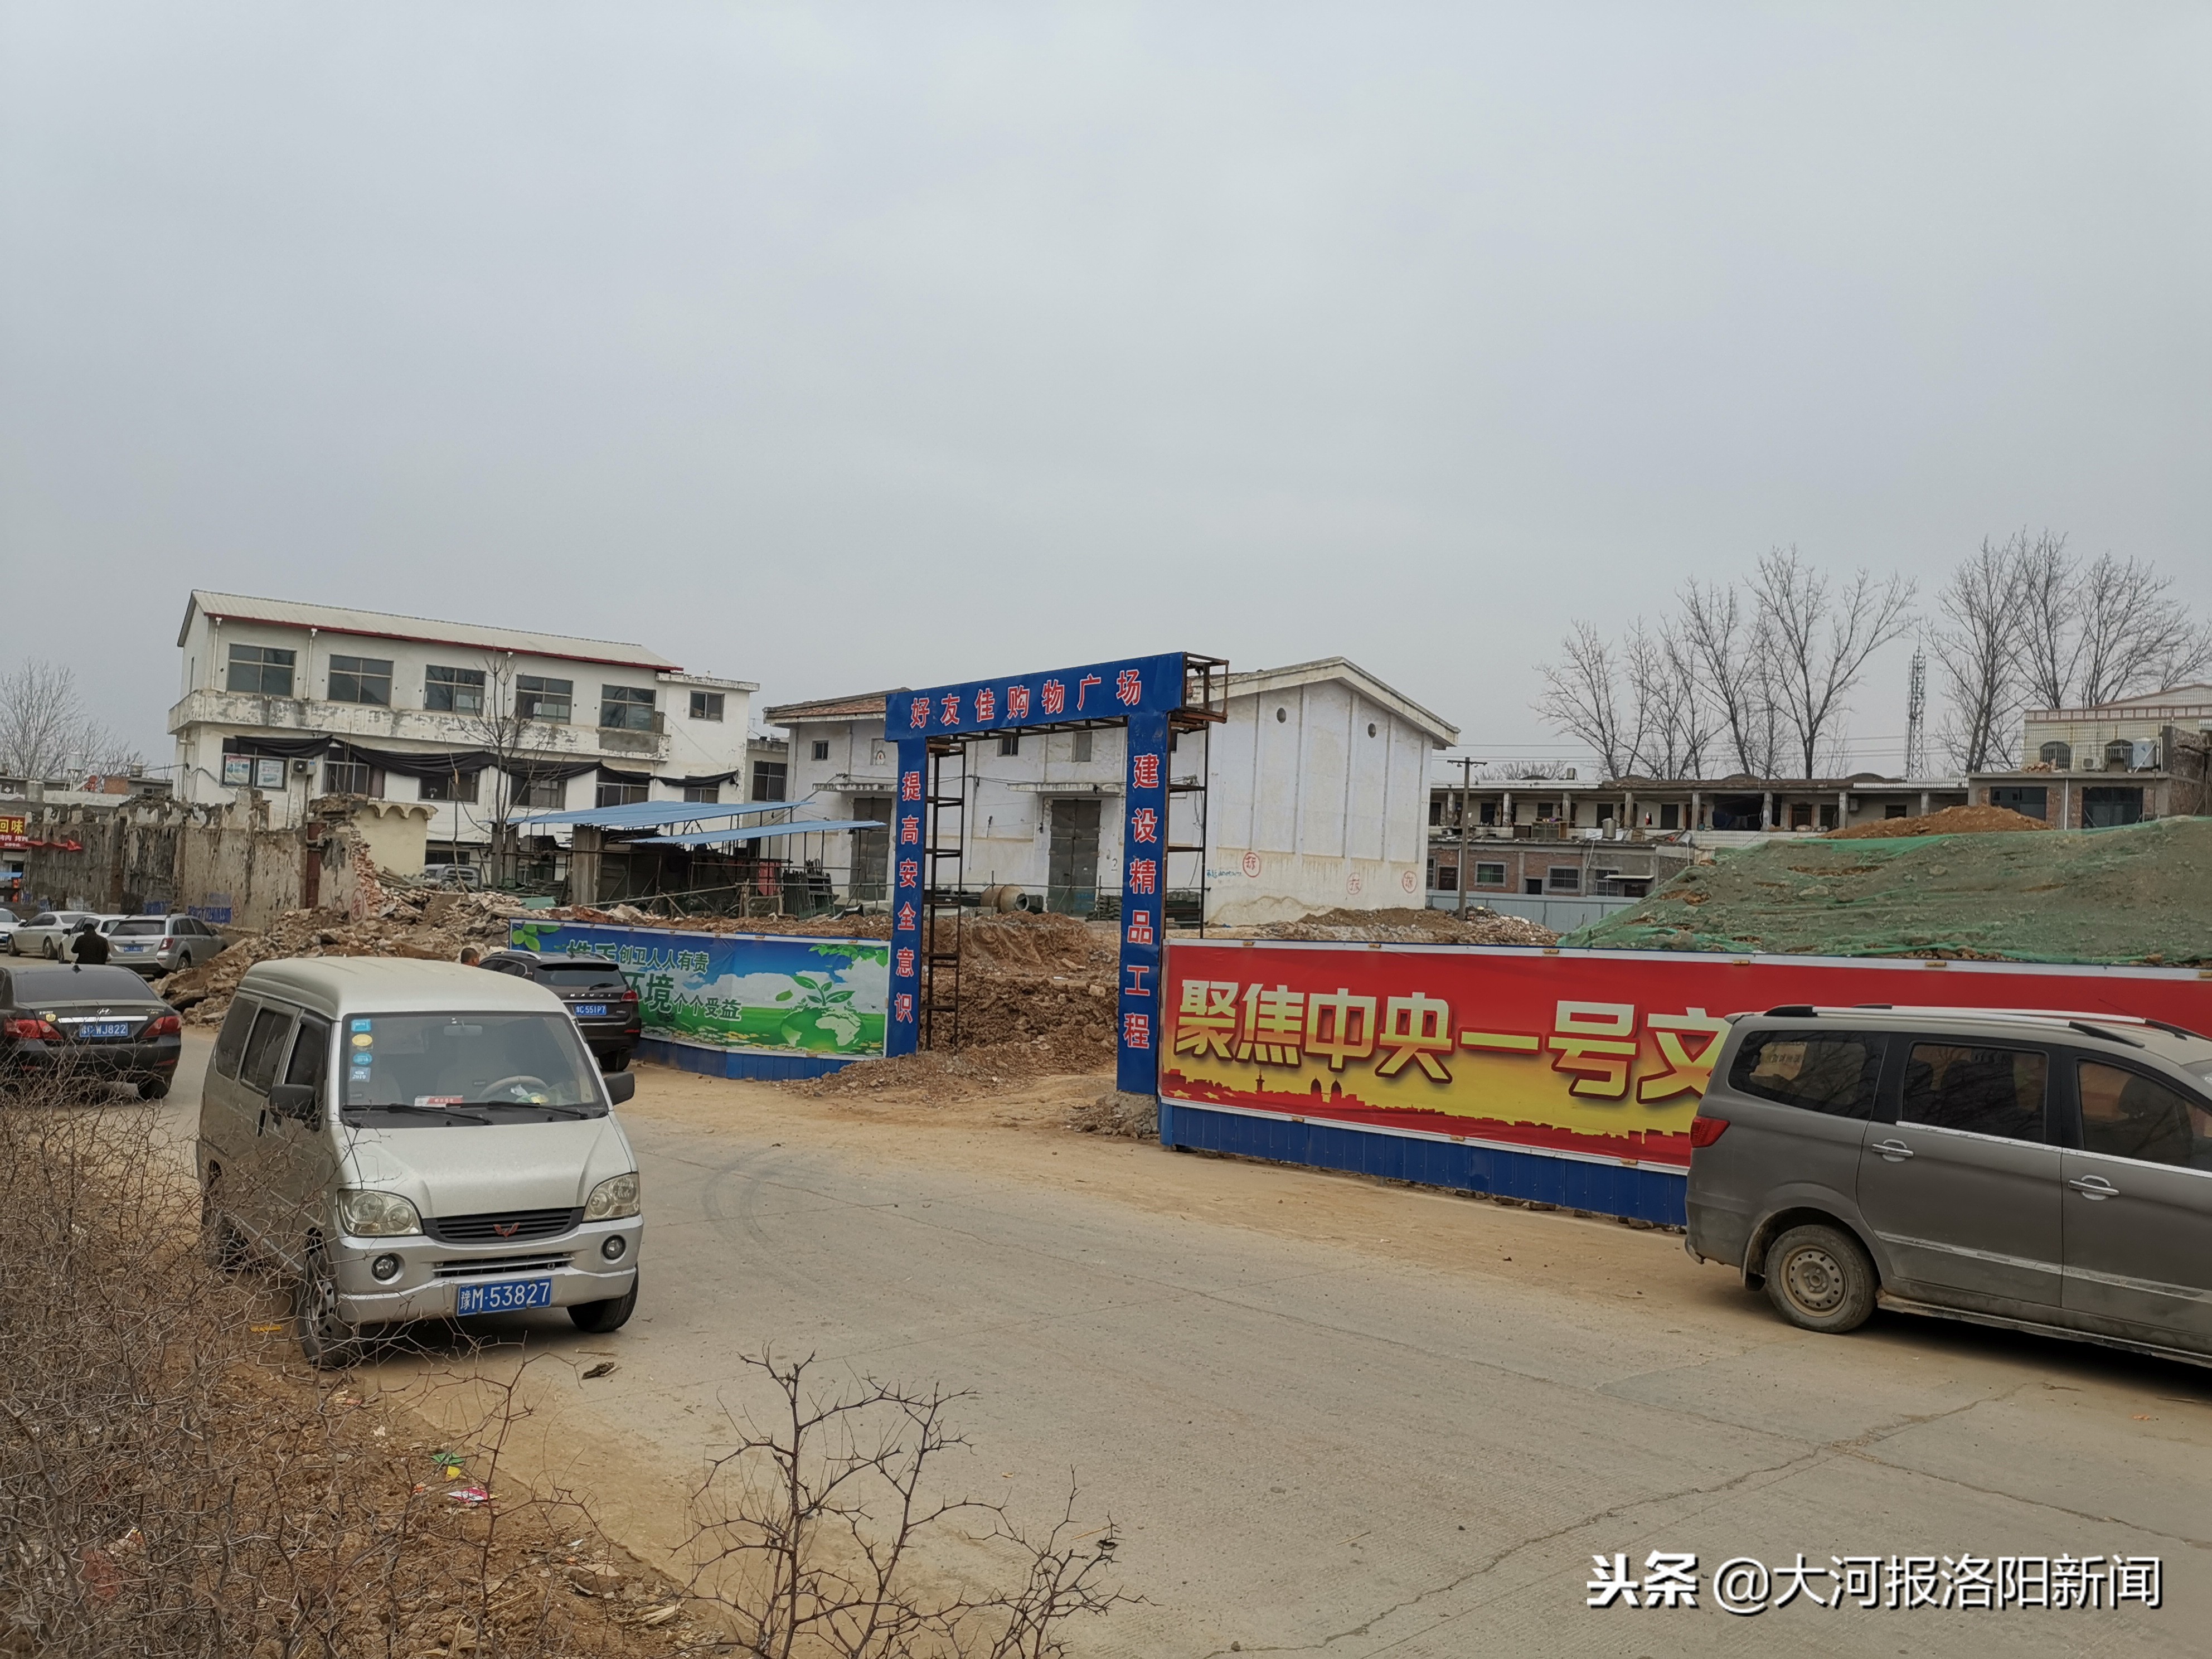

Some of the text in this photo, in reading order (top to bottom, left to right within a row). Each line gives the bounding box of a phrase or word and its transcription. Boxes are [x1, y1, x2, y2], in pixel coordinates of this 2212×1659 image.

[910, 669, 1142, 729] 好友佳购物广场
[894, 770, 921, 1023] 提高安全意识
[1123, 754, 1160, 1049] 建设精品工程
[1174, 978, 1733, 1104] 聚焦中央一号文
